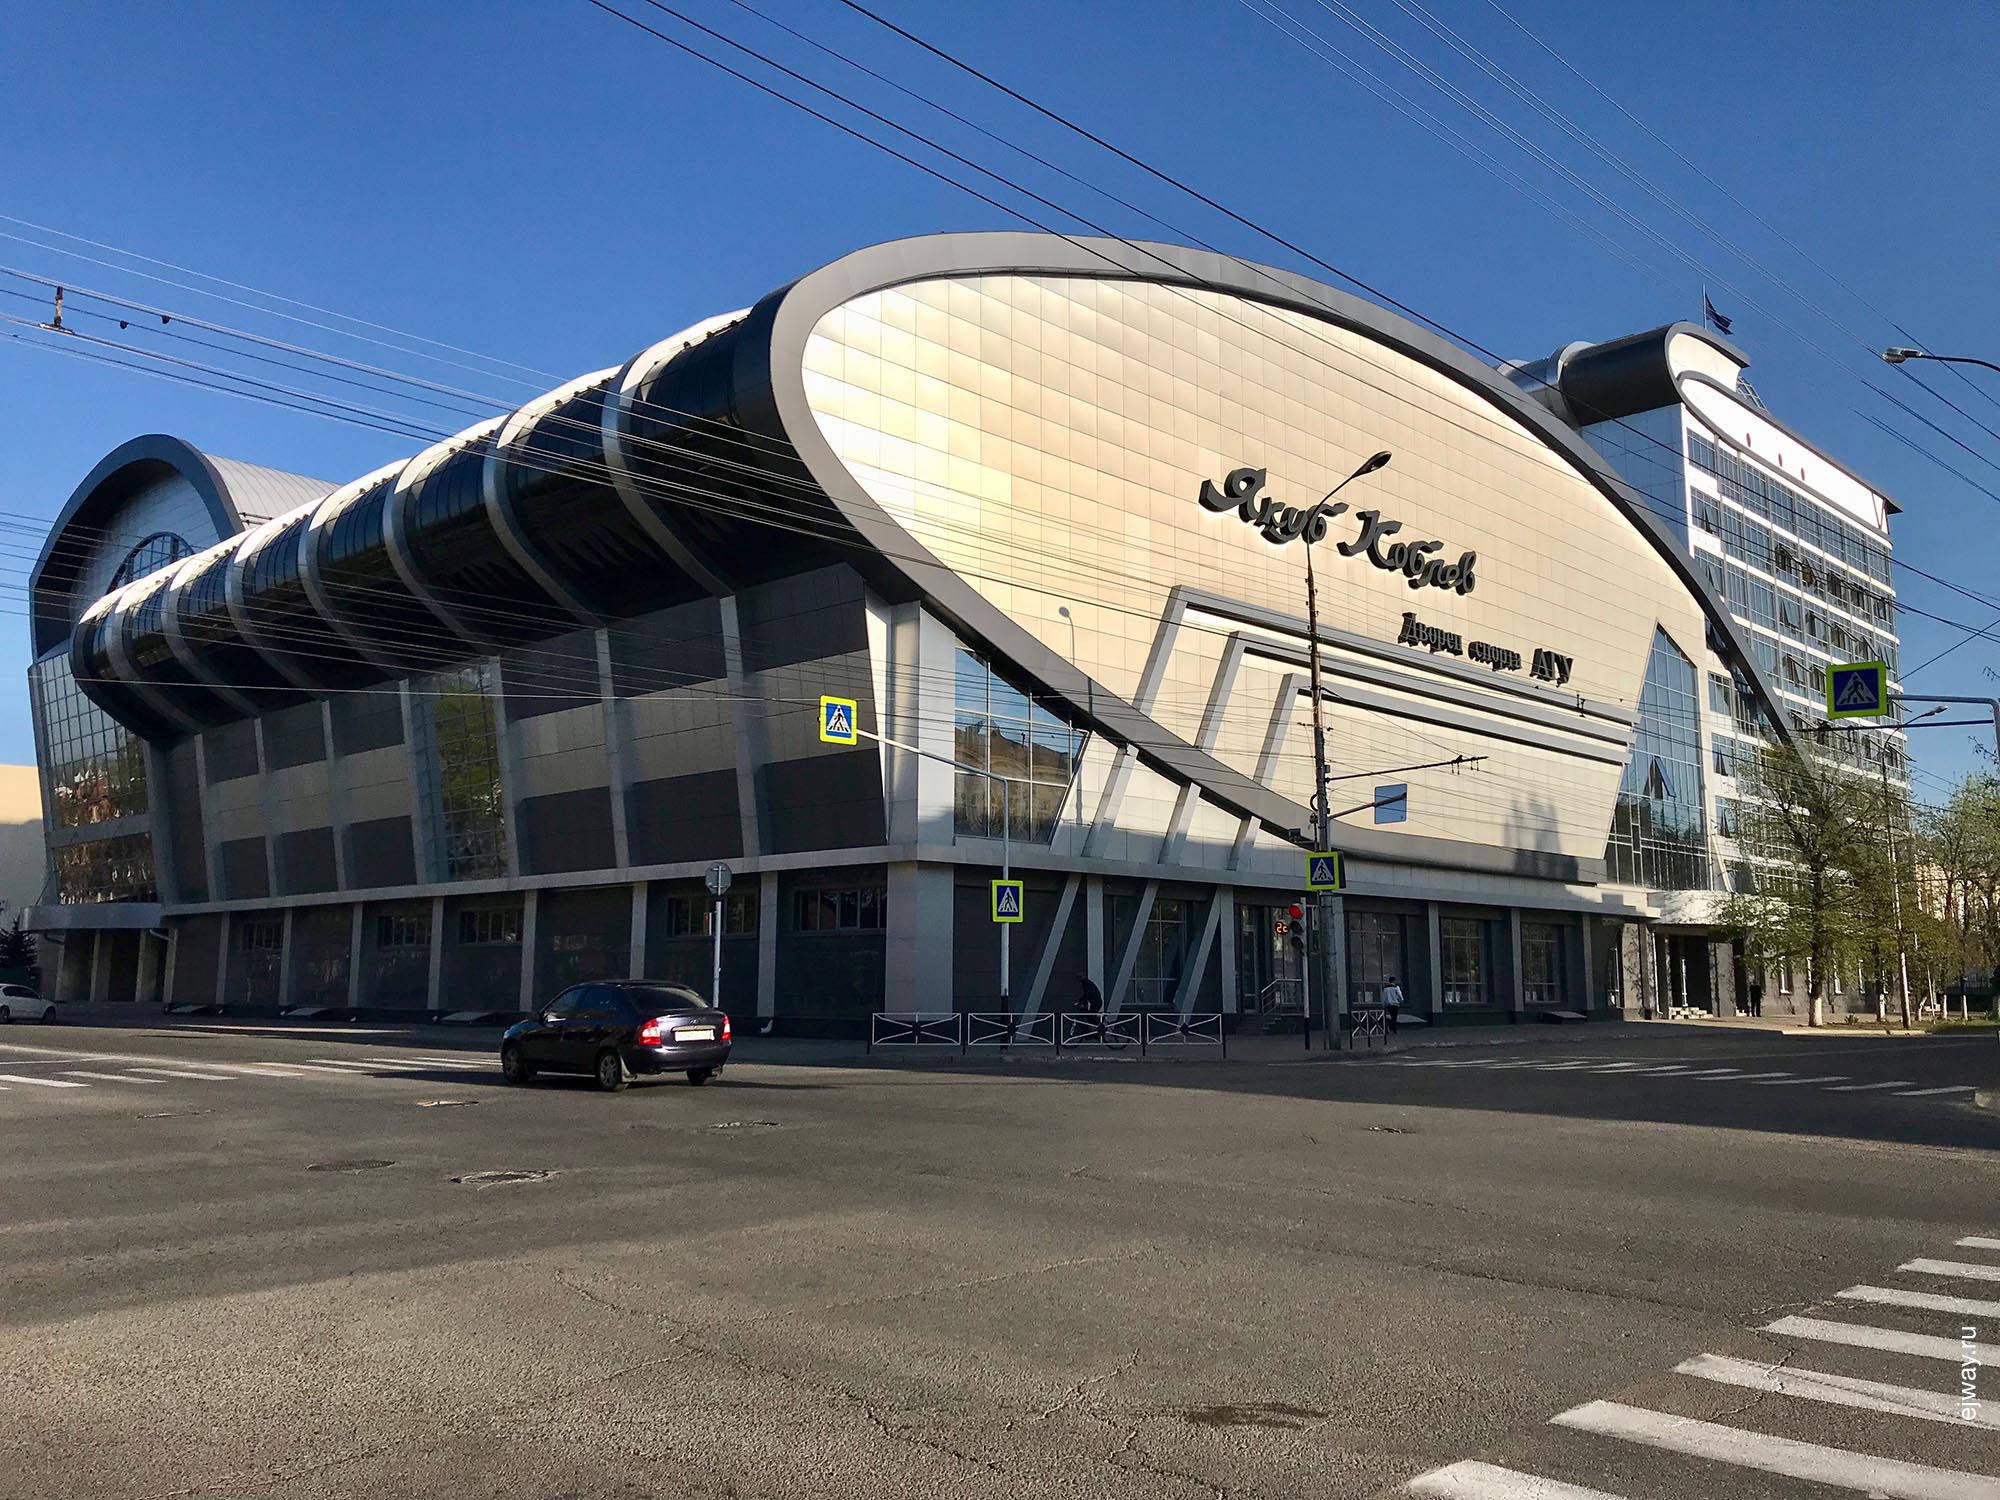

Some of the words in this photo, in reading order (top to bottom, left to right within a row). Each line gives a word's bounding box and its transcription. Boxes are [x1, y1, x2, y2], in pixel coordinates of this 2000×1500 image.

[1198, 467, 1349, 545] Якуб
[1336, 510, 1476, 595] Коблев
[1397, 612, 1463, 656] Дворец
[1468, 641, 1522, 672] спорта
[1529, 648, 1573, 688] АГУ
